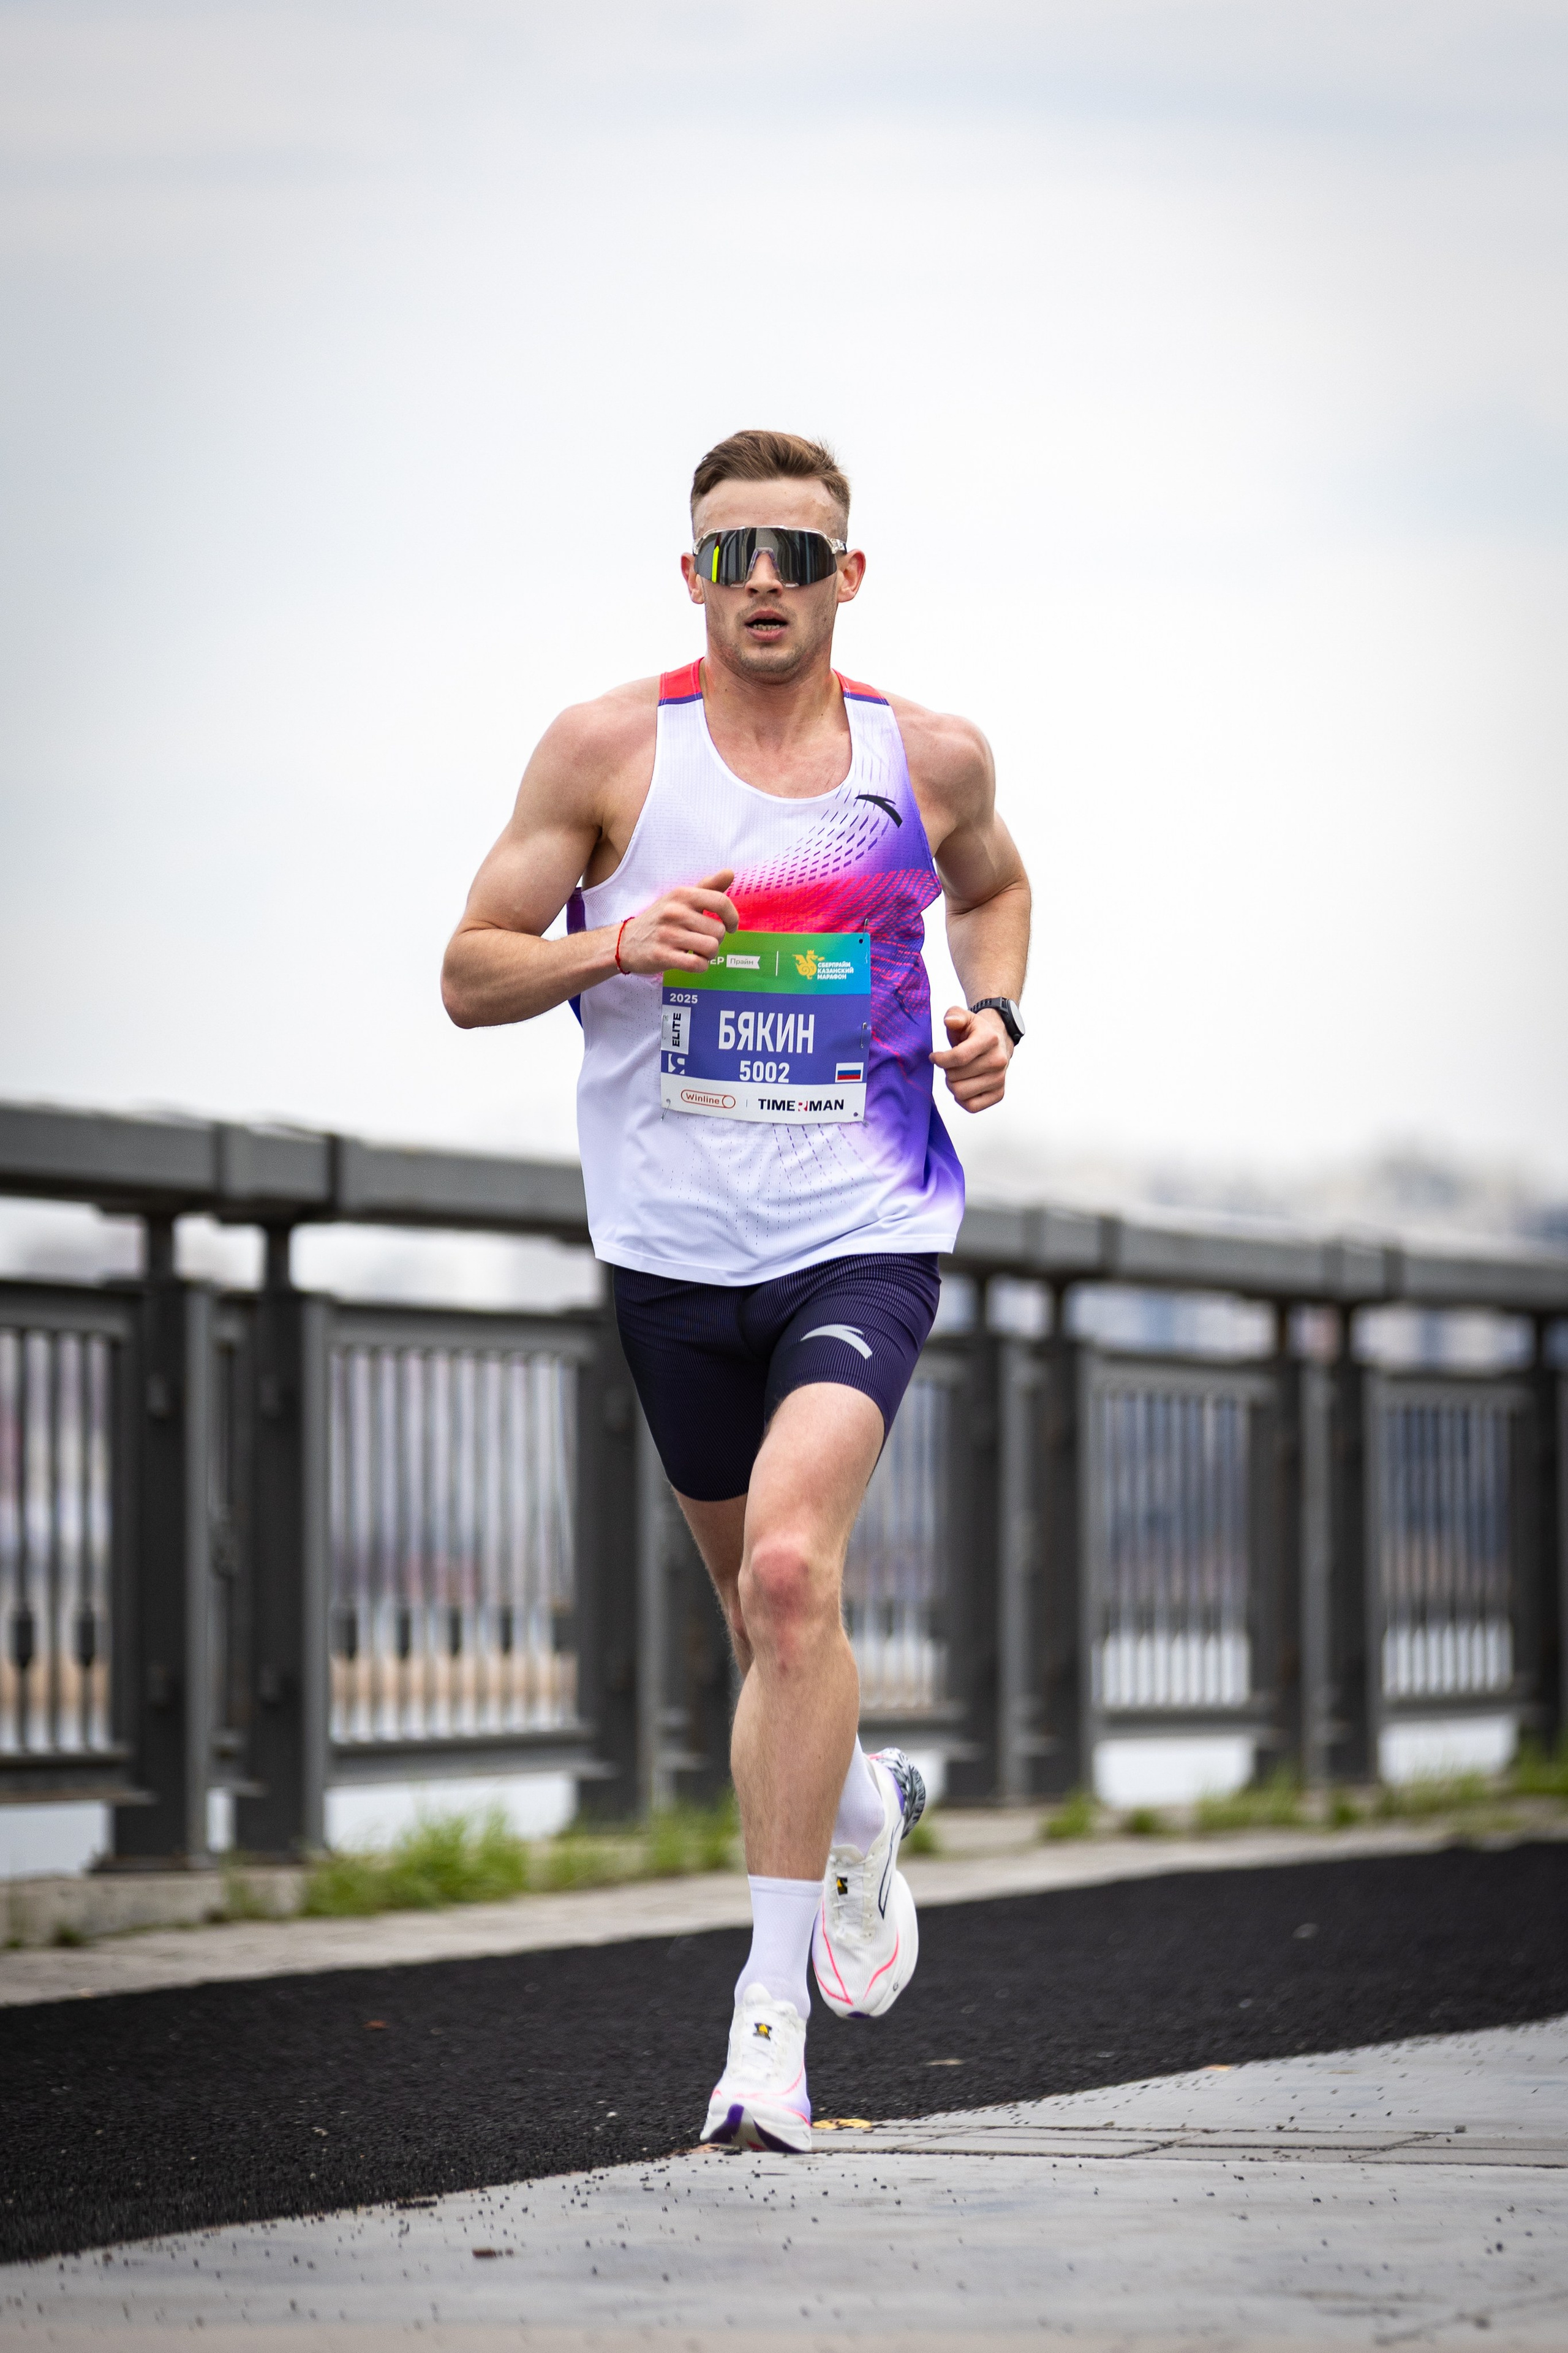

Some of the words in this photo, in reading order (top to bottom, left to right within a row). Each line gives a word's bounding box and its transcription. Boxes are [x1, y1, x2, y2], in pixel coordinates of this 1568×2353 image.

[669, 992, 698, 1004] 2025
[672, 1012, 682, 1048] ELITE
[718, 1010, 815, 1054] БЯКИН
[739, 1060, 790, 1084] 5002
[685, 1092, 720, 1105] Winline
